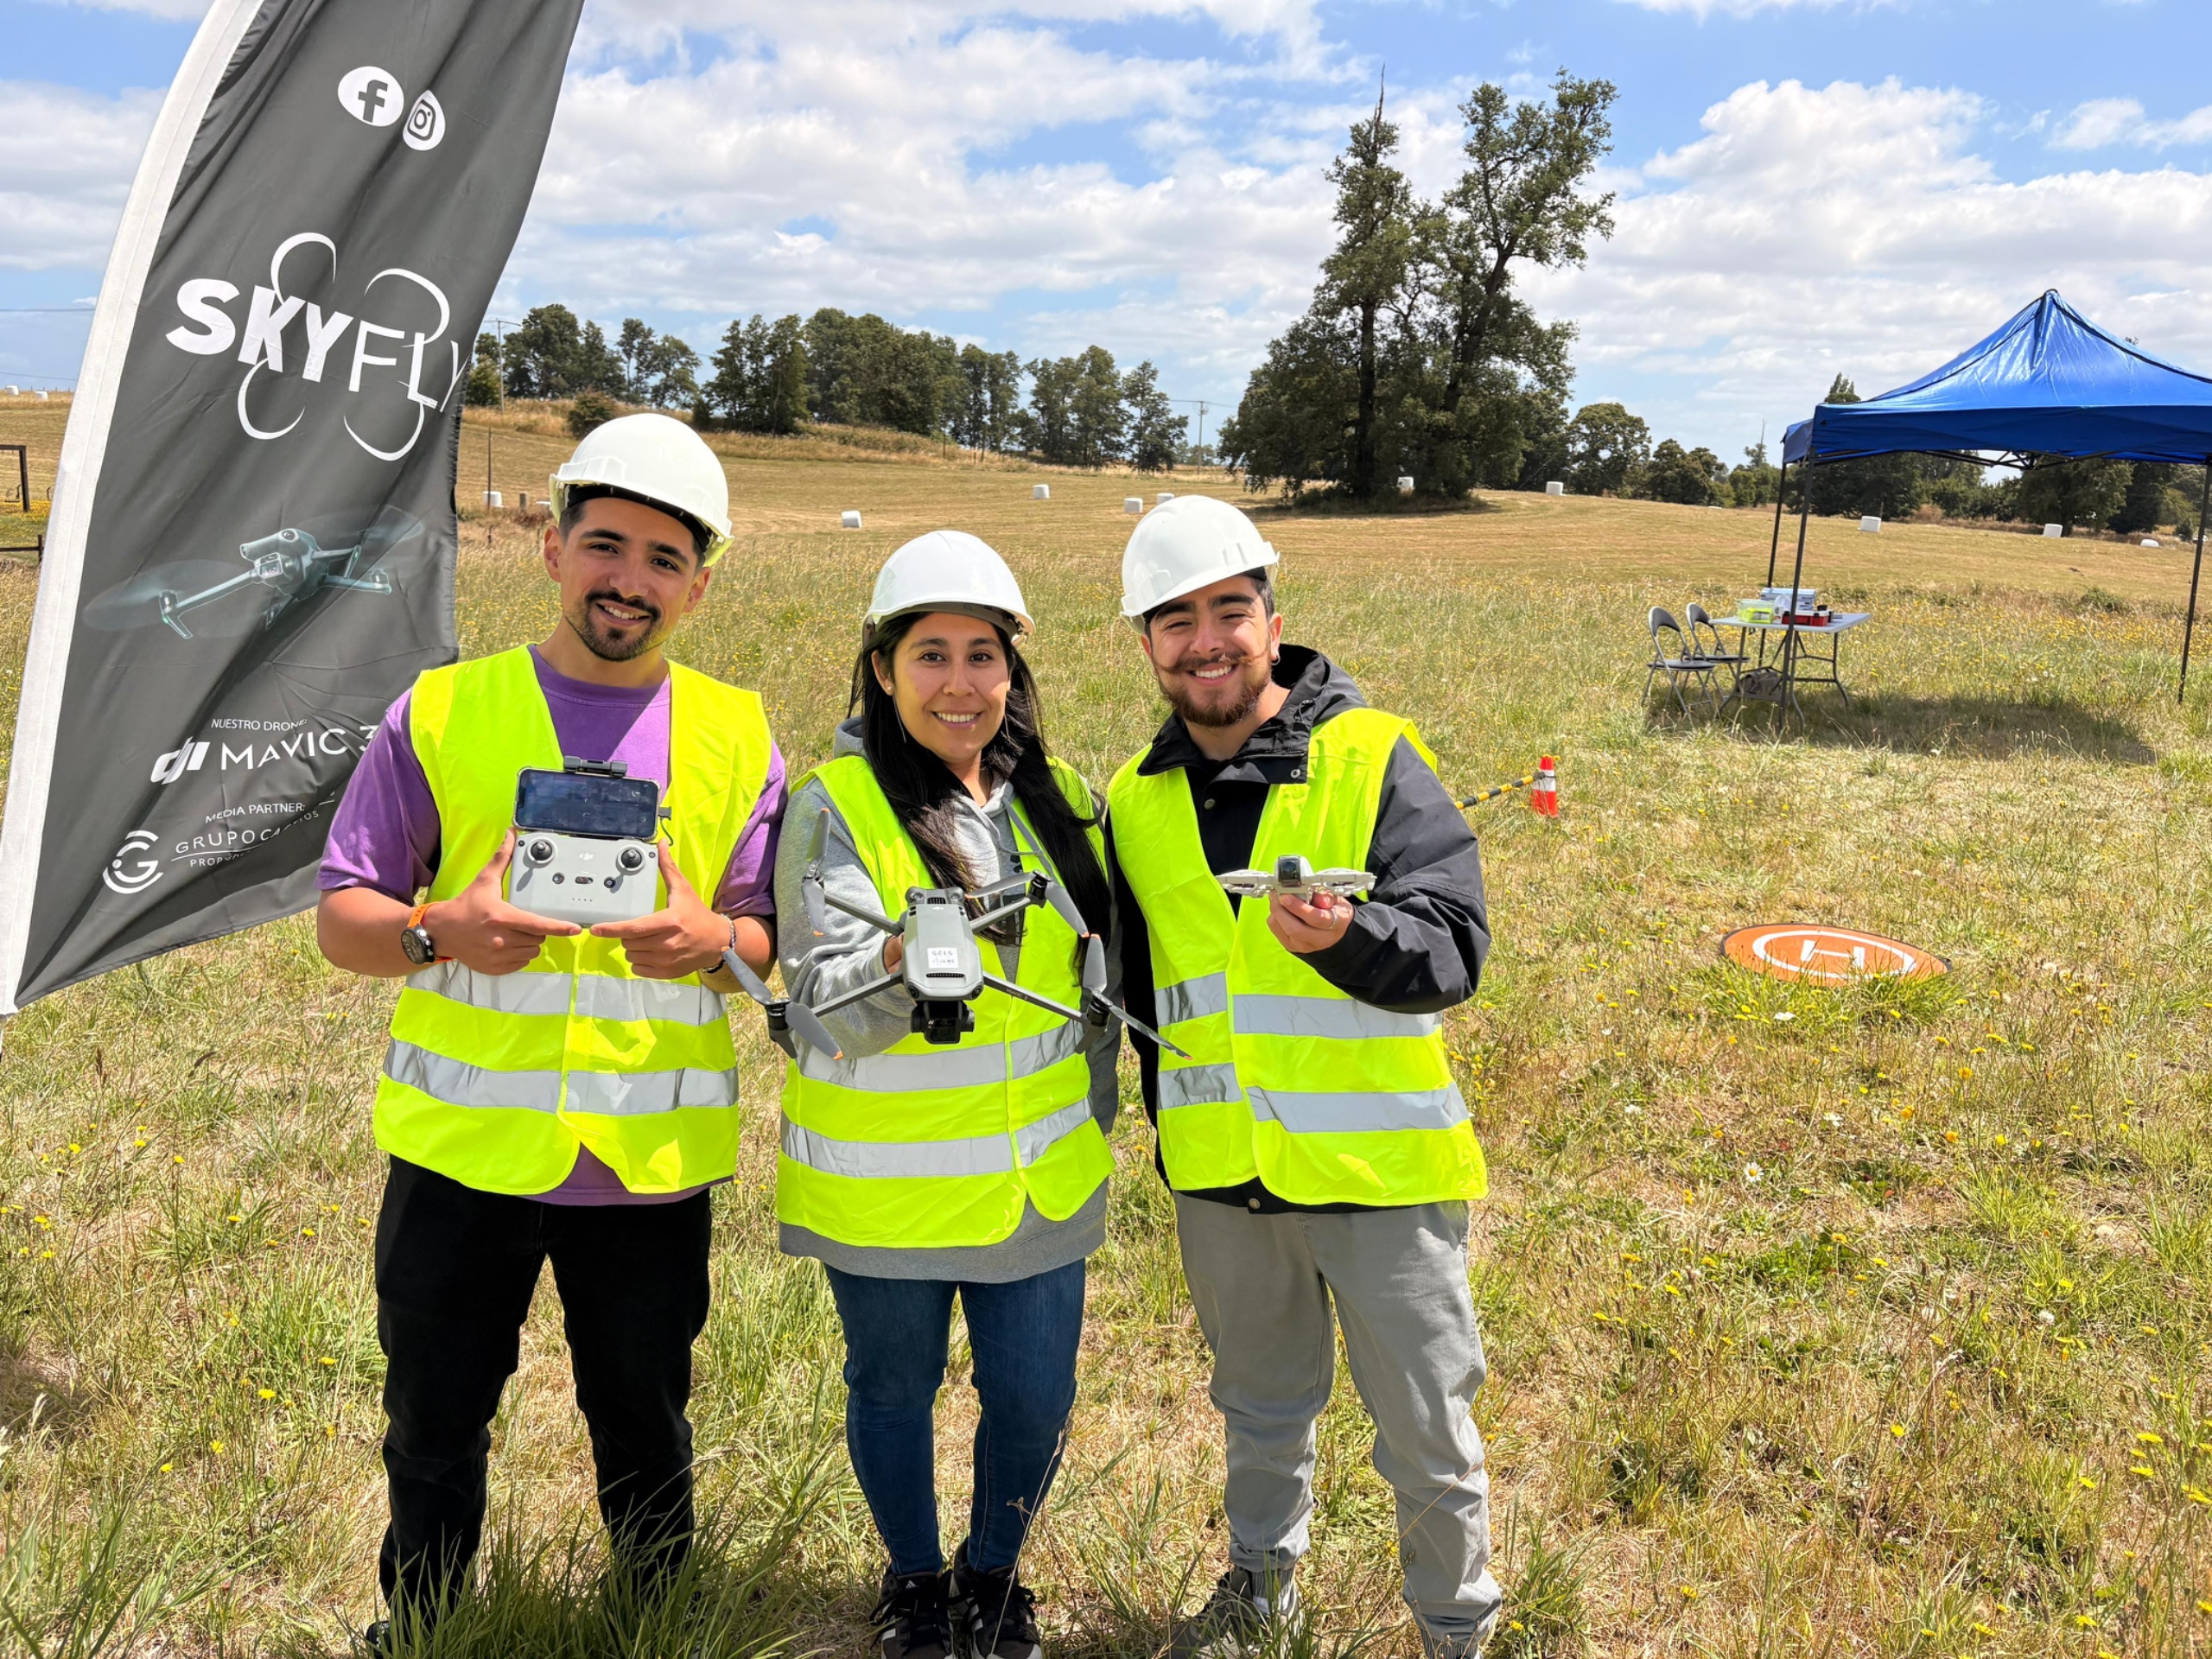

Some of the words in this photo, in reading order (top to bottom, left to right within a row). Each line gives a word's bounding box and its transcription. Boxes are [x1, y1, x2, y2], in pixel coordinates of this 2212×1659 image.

[165, 278, 471, 412] SKYFLY
[211, 718, 261, 730] NUESTRO
[221, 728, 347, 771] MAVIC
[206, 805, 246, 824] MEDIA
[248, 802, 306, 816] PARTNER:
